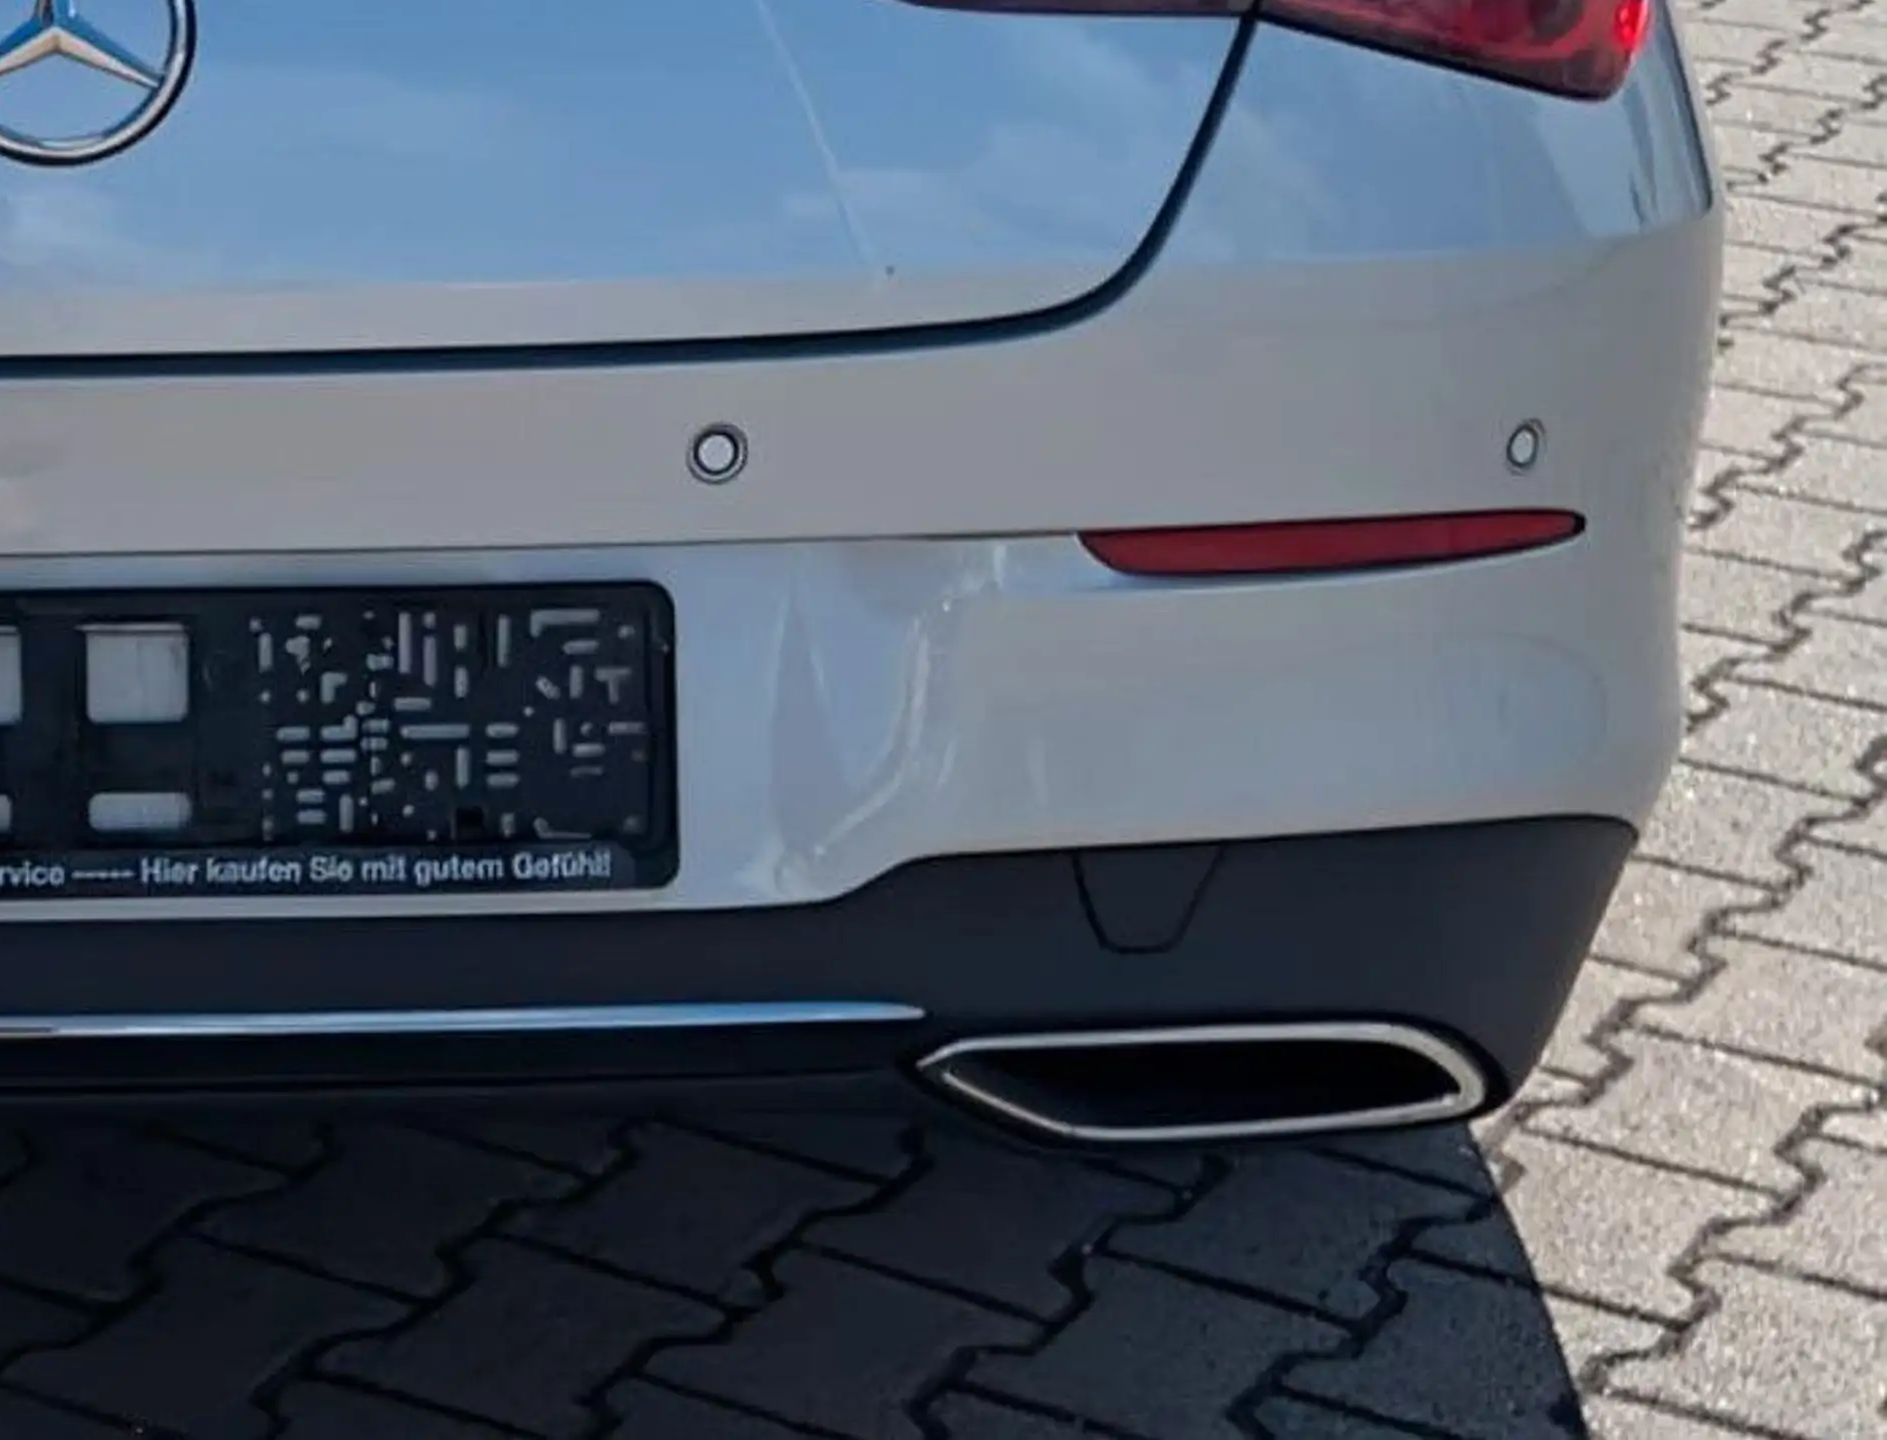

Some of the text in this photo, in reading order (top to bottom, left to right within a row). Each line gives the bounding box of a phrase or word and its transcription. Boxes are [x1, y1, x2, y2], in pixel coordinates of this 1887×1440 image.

[141, 857, 199, 884] Hier
[206, 856, 302, 883] kaufen
[309, 855, 354, 882] Sie
[361, 853, 408, 882] mit
[414, 854, 505, 886] gutem
